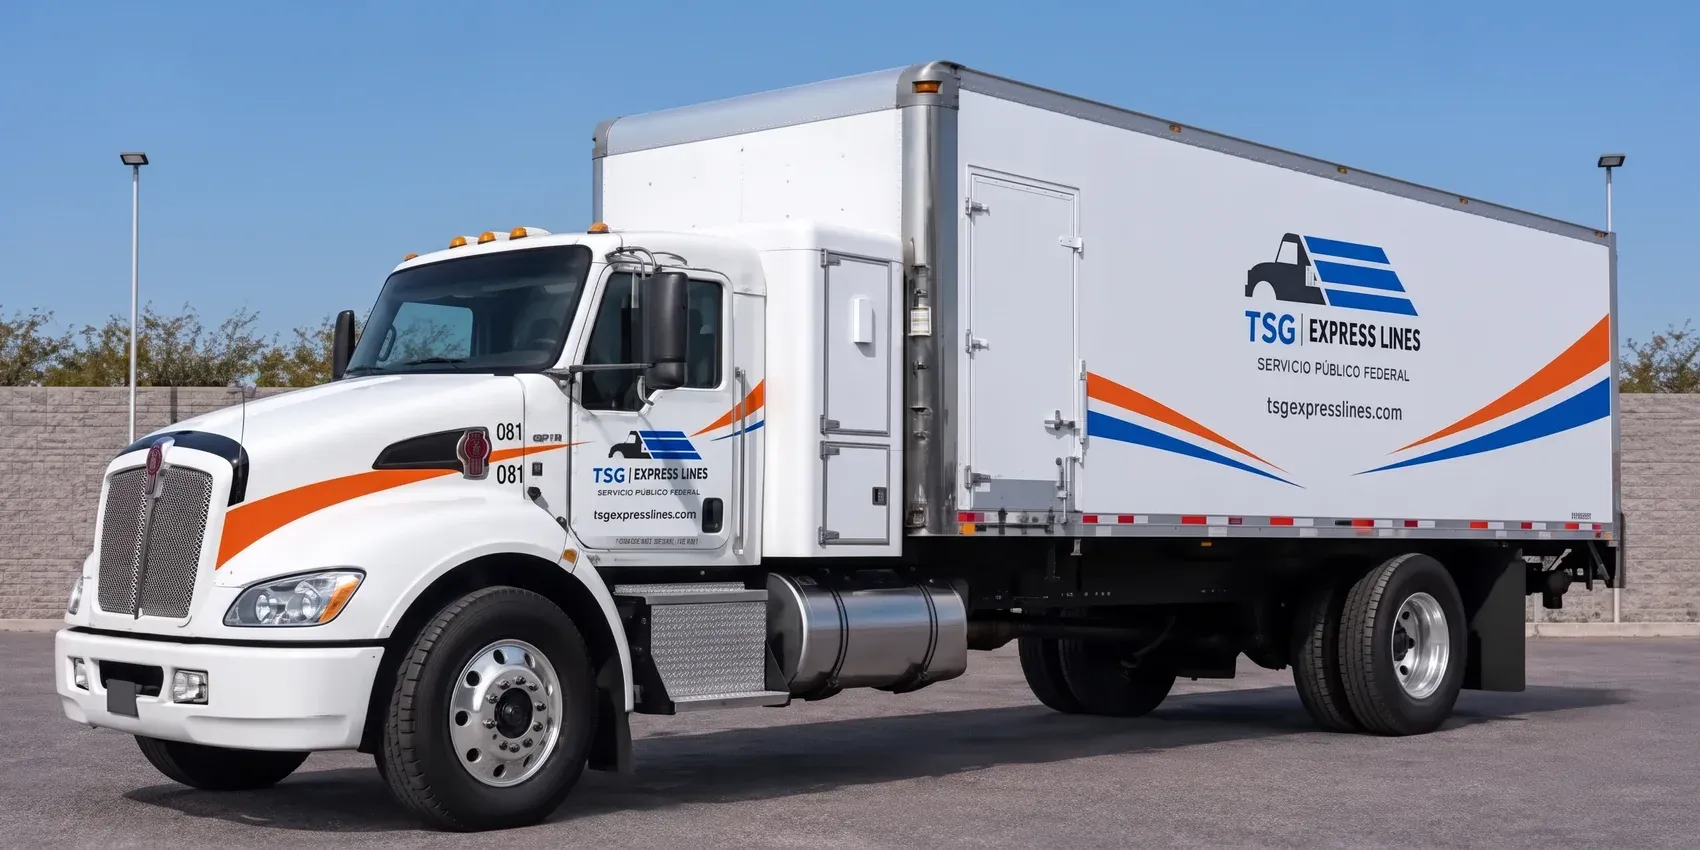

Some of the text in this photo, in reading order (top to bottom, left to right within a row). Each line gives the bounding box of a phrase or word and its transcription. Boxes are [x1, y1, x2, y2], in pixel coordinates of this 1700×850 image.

[1245, 310, 1421, 352] TSG EXPRESS LINES
[1257, 357, 1410, 382] SERVICIO PÚBLICO FEDERAL
[1267, 397, 1403, 420] tsgexpresslines.com
[496, 422, 522, 441] 081
[496, 464, 523, 484] 081
[592, 467, 708, 484] TSG EXPRESS LINES
[635, 488, 668, 496] PÚBLICO
[593, 509, 697, 522] tsgexpresslines.com
